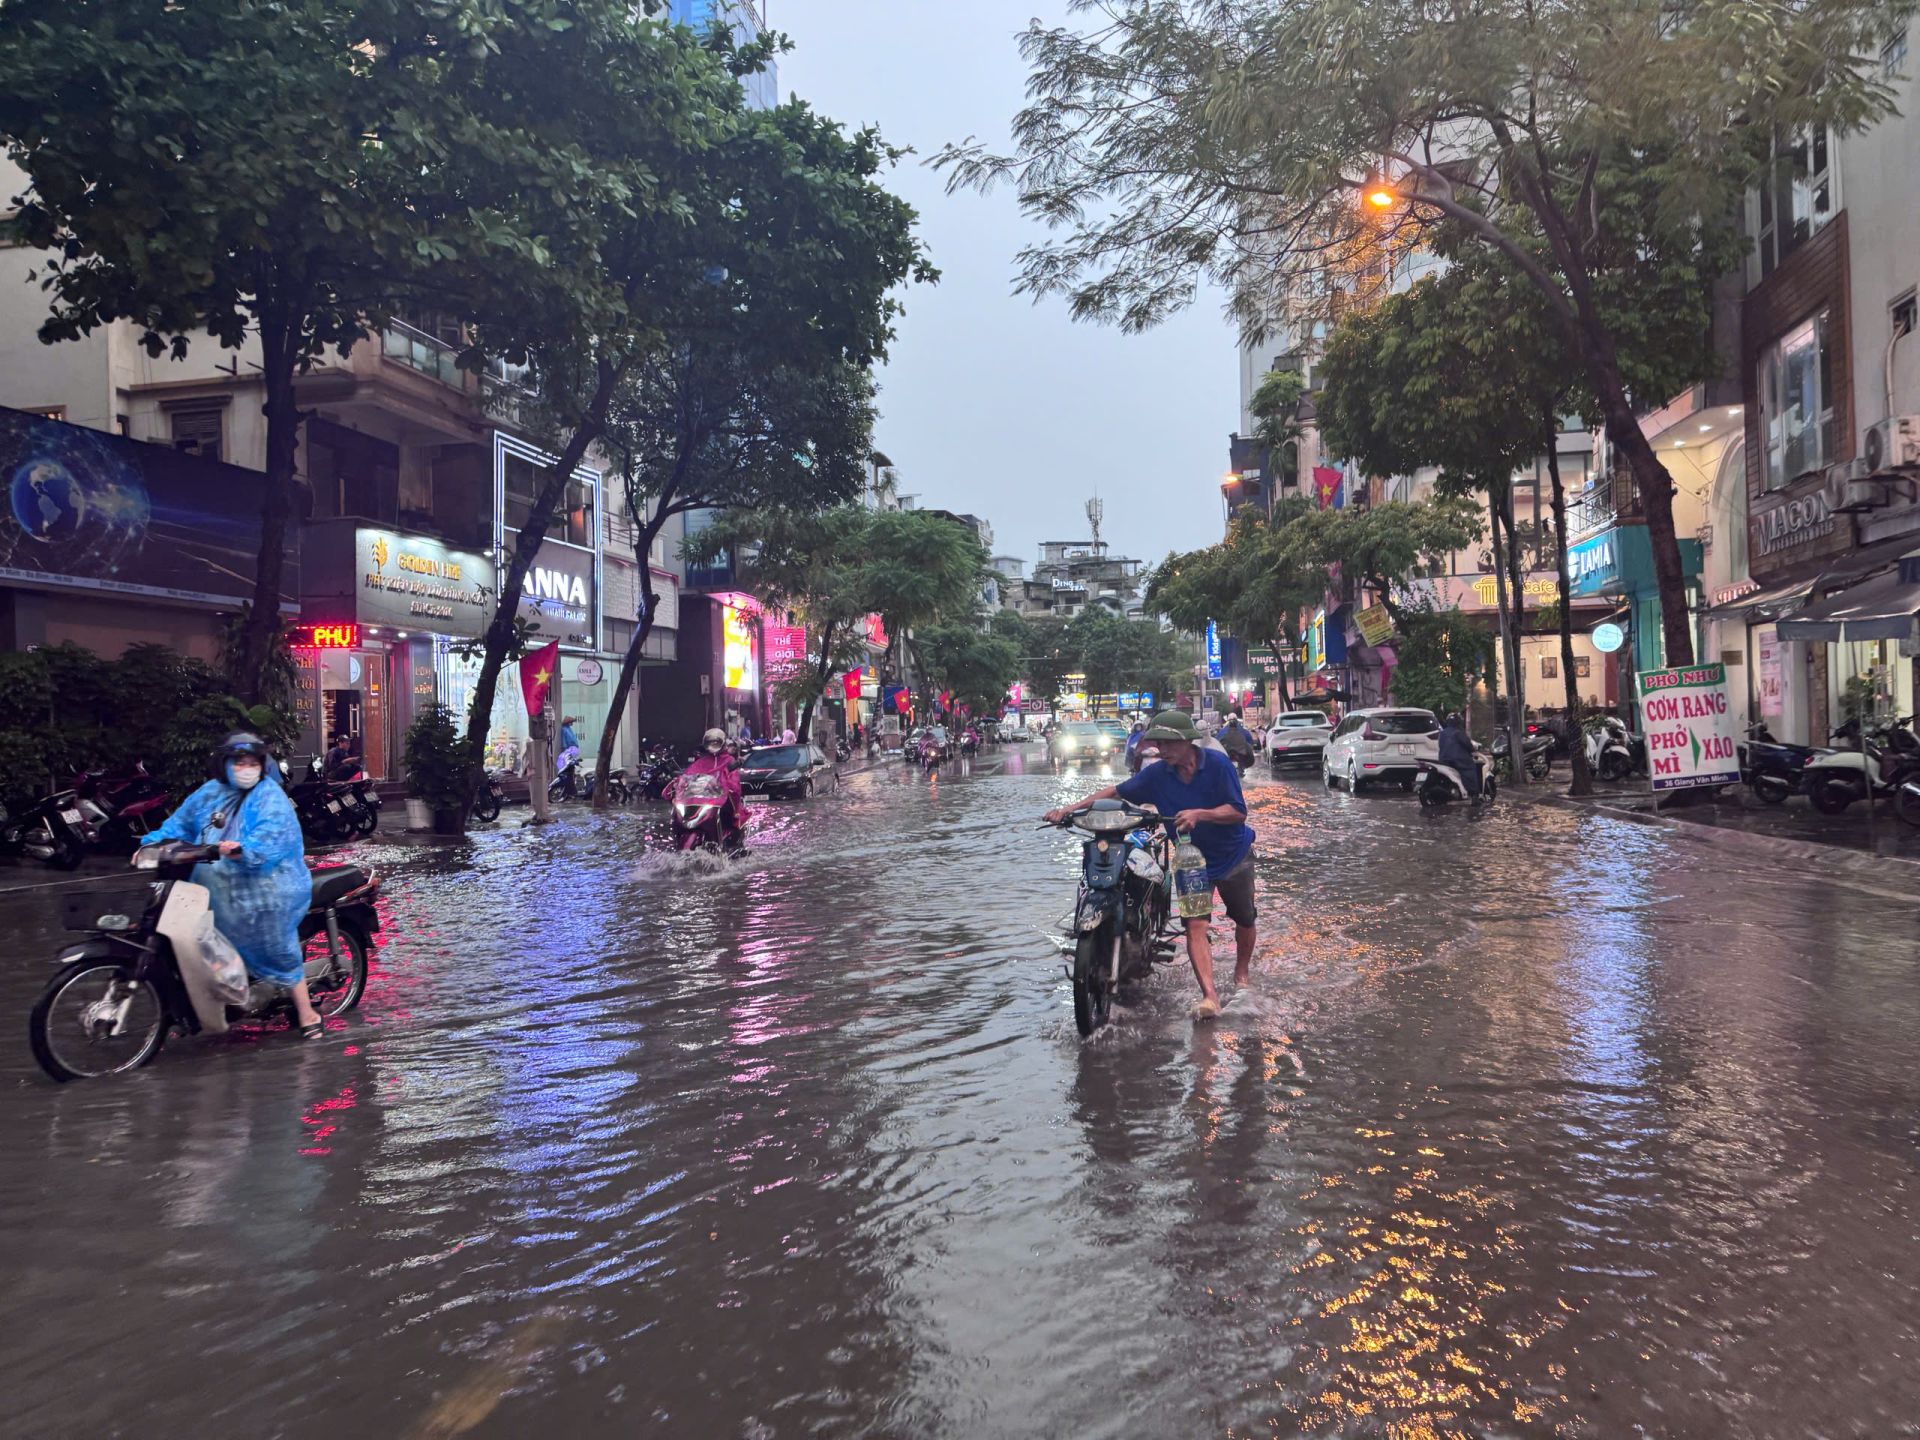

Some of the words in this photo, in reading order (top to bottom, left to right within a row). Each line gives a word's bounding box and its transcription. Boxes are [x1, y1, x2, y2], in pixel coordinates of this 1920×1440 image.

[1581, 542, 1611, 575] LAMIA
[314, 628, 350, 646] PHỤ
[774, 633, 793, 645] THẾ
[775, 648, 795, 659] GIỚI
[1646, 695, 1680, 721] CƠM
[1681, 692, 1727, 718] RANG
[1650, 723, 1689, 750] PHỞ
[1702, 733, 1734, 761] XÀO
[1653, 752, 1681, 775] MÌ
[1674, 778, 1695, 787] Giang
